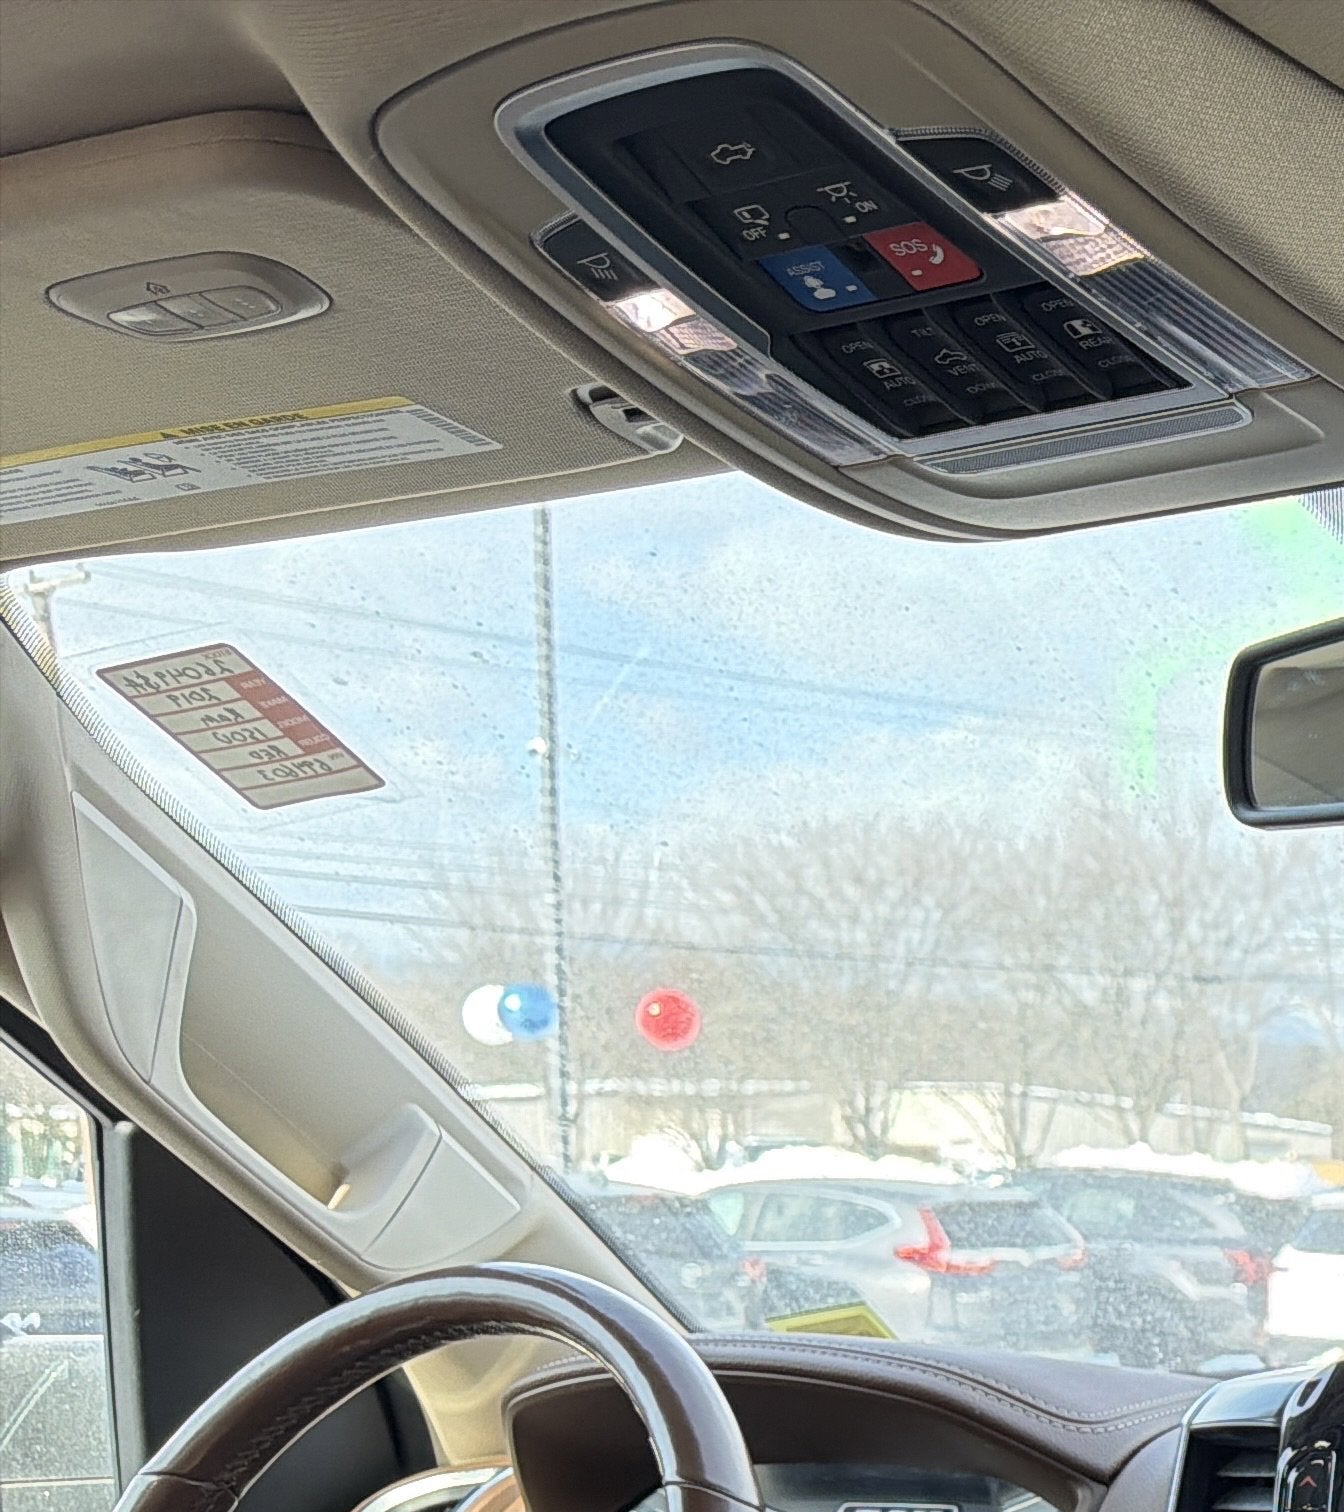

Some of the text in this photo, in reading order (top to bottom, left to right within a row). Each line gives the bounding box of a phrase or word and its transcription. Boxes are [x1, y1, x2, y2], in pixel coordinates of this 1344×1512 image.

[855, 201, 878, 213] ON
[742, 227, 767, 241] OFF
[889, 239, 928, 257] SOS
[786, 261, 826, 277] ASSIST
[1014, 349, 1048, 364] AUTO
[883, 375, 917, 391] AUTO
